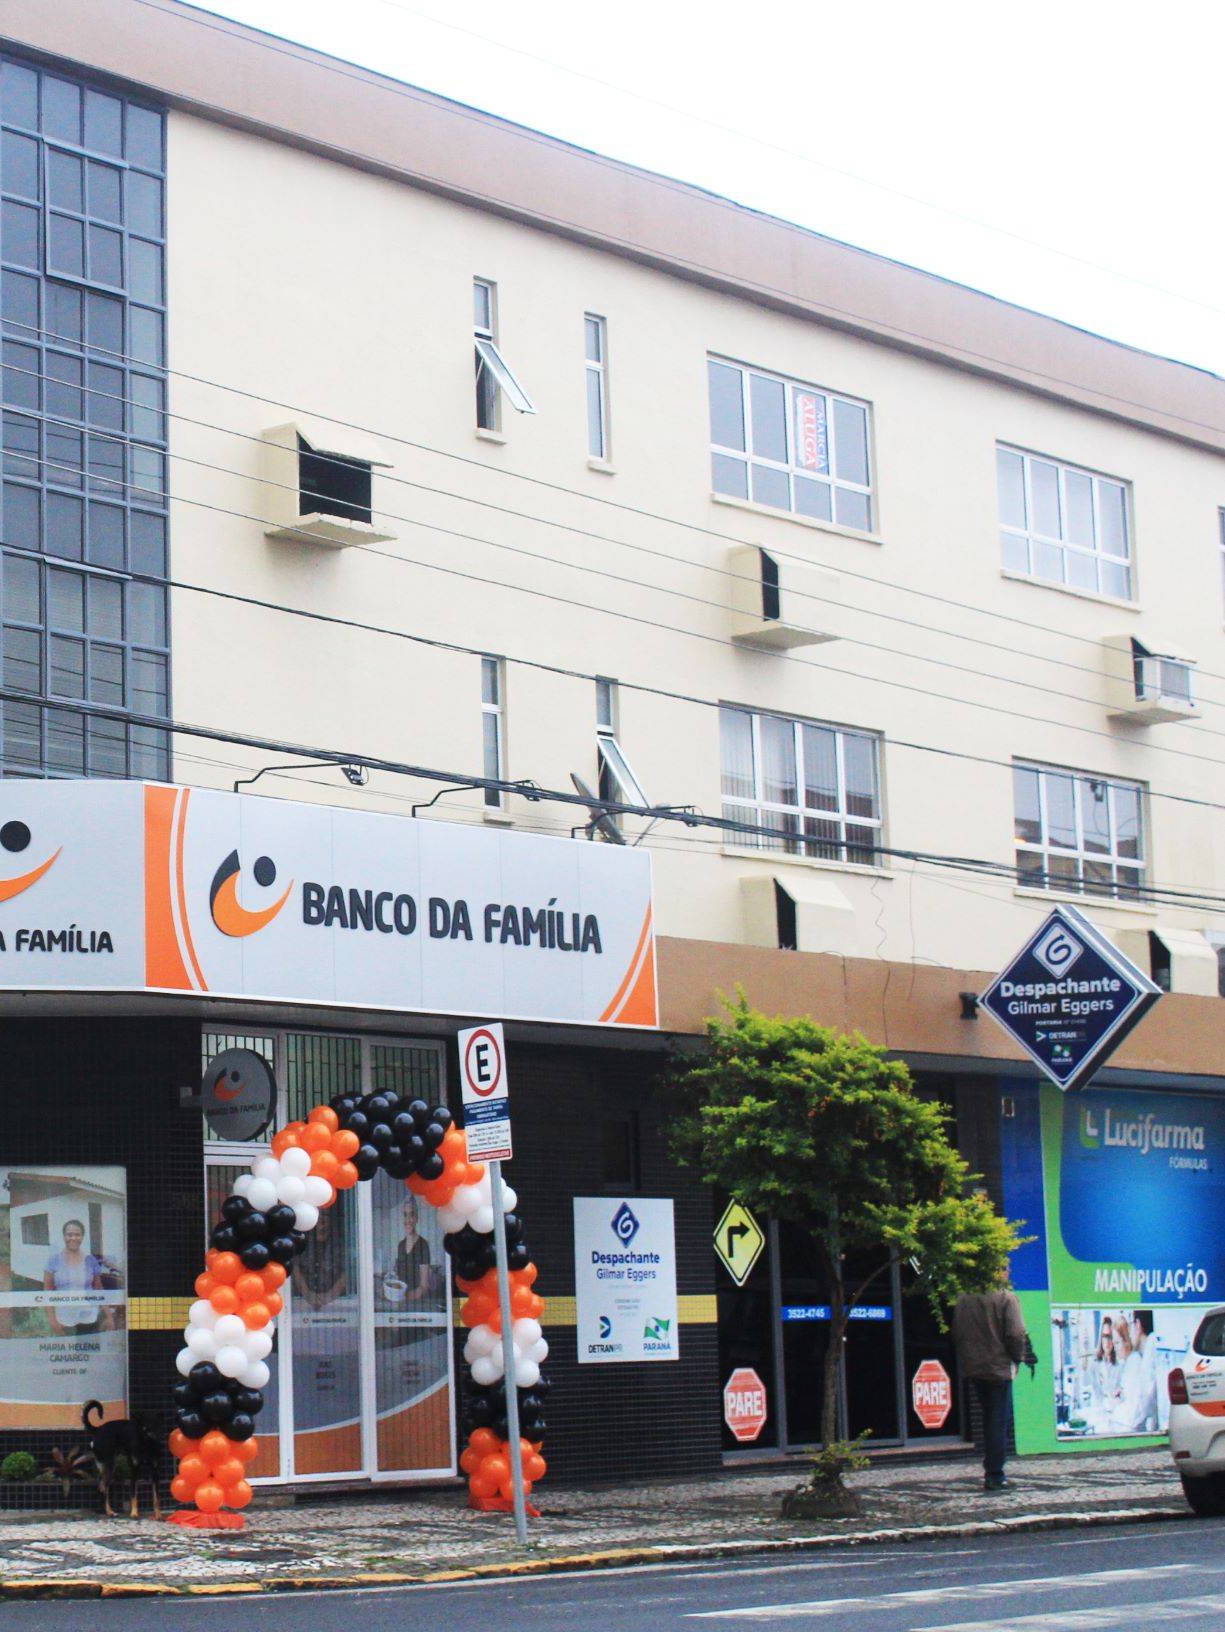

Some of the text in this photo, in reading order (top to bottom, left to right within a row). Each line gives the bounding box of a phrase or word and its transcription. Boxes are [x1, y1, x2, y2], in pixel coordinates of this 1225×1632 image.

[302, 882, 603, 954] BANCO DA FAMÍLIA
[15, 924, 114, 953] FAMÍLIA
[1000, 977, 1121, 999] Despachante
[1008, 999, 1114, 1015] Gilmar Eggers
[475, 1043, 491, 1082] E
[1105, 1108, 1205, 1154] Lucifarma
[592, 1251, 660, 1267] Despachante
[596, 1268, 656, 1282] Gilmar Eggers
[1094, 1263, 1208, 1299] MANIPULAÇÃO
[39, 1342, 101, 1352] MARIA HELENA
[49, 1353, 90, 1362] CAMARGO
[727, 1391, 762, 1416] PARE
[914, 1381, 948, 1406] PARE
